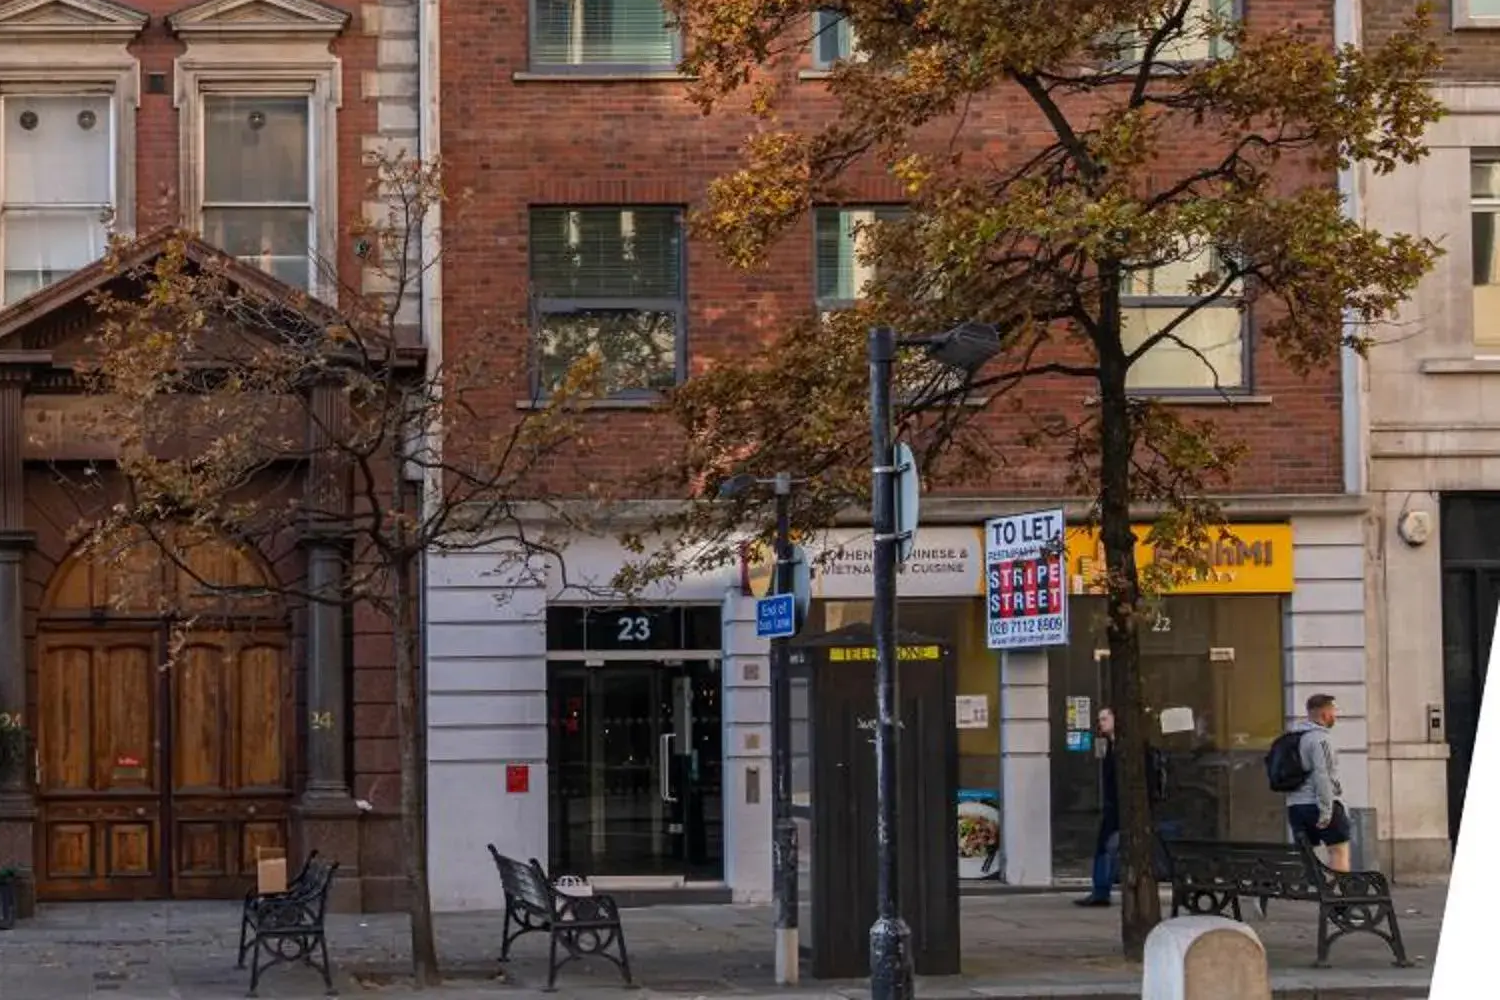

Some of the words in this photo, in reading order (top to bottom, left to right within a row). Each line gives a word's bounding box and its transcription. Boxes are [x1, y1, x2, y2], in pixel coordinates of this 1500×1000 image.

[992, 521, 1016, 545] TO
[1022, 516, 1054, 541] LET
[911, 563, 965, 574] CUISINE
[991, 563, 1060, 589] STRIPE
[991, 588, 1060, 613] STREET
[617, 617, 650, 641] 23
[1152, 617, 1172, 632] 22
